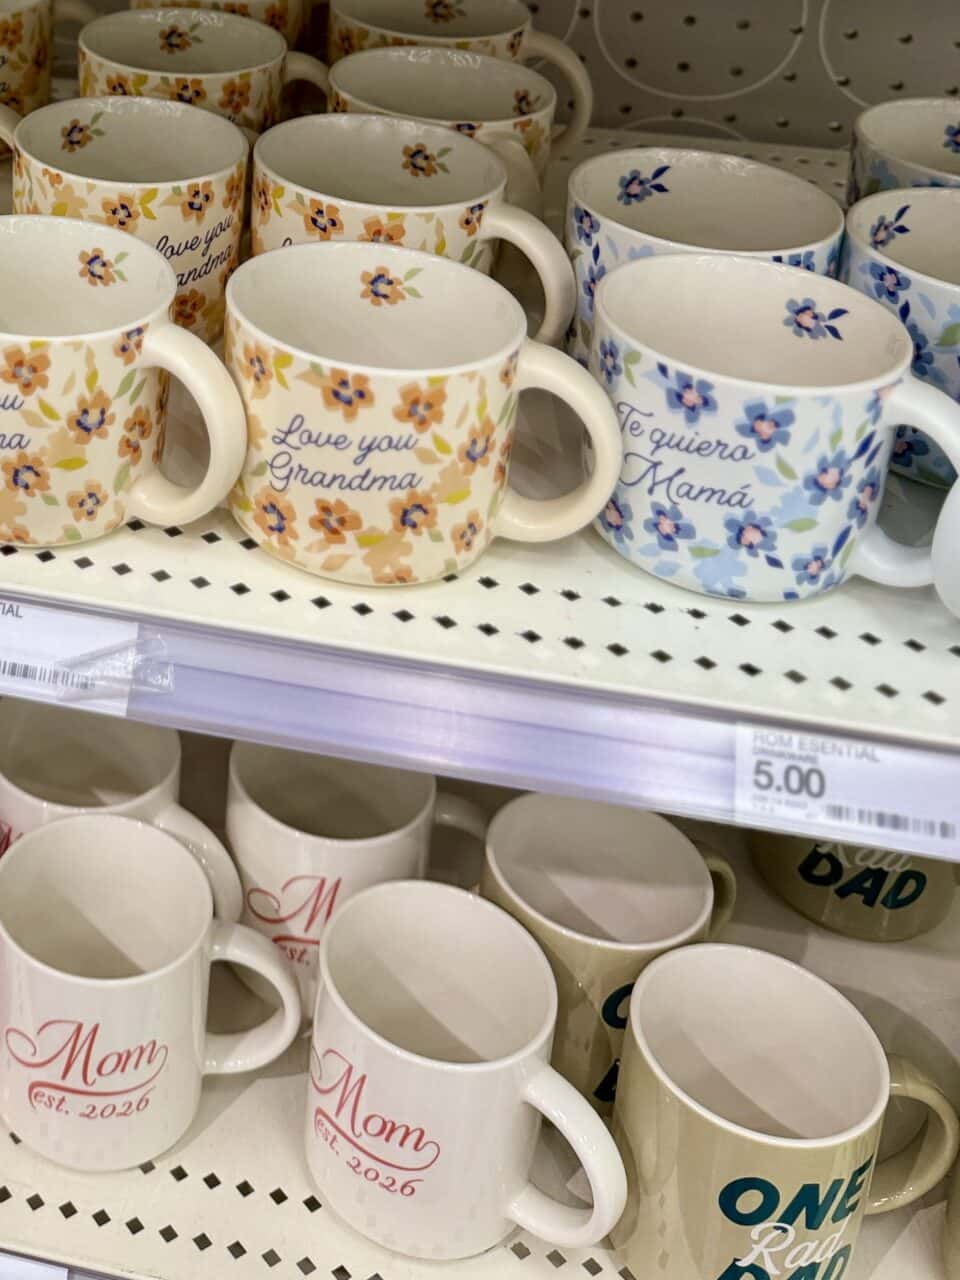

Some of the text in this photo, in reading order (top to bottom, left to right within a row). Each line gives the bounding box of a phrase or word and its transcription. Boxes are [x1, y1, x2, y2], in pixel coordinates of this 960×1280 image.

[201, 214, 234, 257] you
[176, 244, 234, 286] andma
[271, 414, 419, 466] Love you
[617, 401, 757, 463] Te quiero
[265, 451, 424, 493] Grandma
[619, 452, 755, 509] Mamá
[797, 734, 881, 764] ESENTIAL
[753, 759, 826, 799] 5.00
[798, 844, 927, 910] DAD
[5, 1019, 169, 1094] Mom
[33, 1085, 157, 1120] est. 2026
[311, 1048, 441, 1154] Mom
[346, 1155, 425, 1199] 2026
[719, 1154, 874, 1231] ONE
[735, 1212, 853, 1275] Rad
